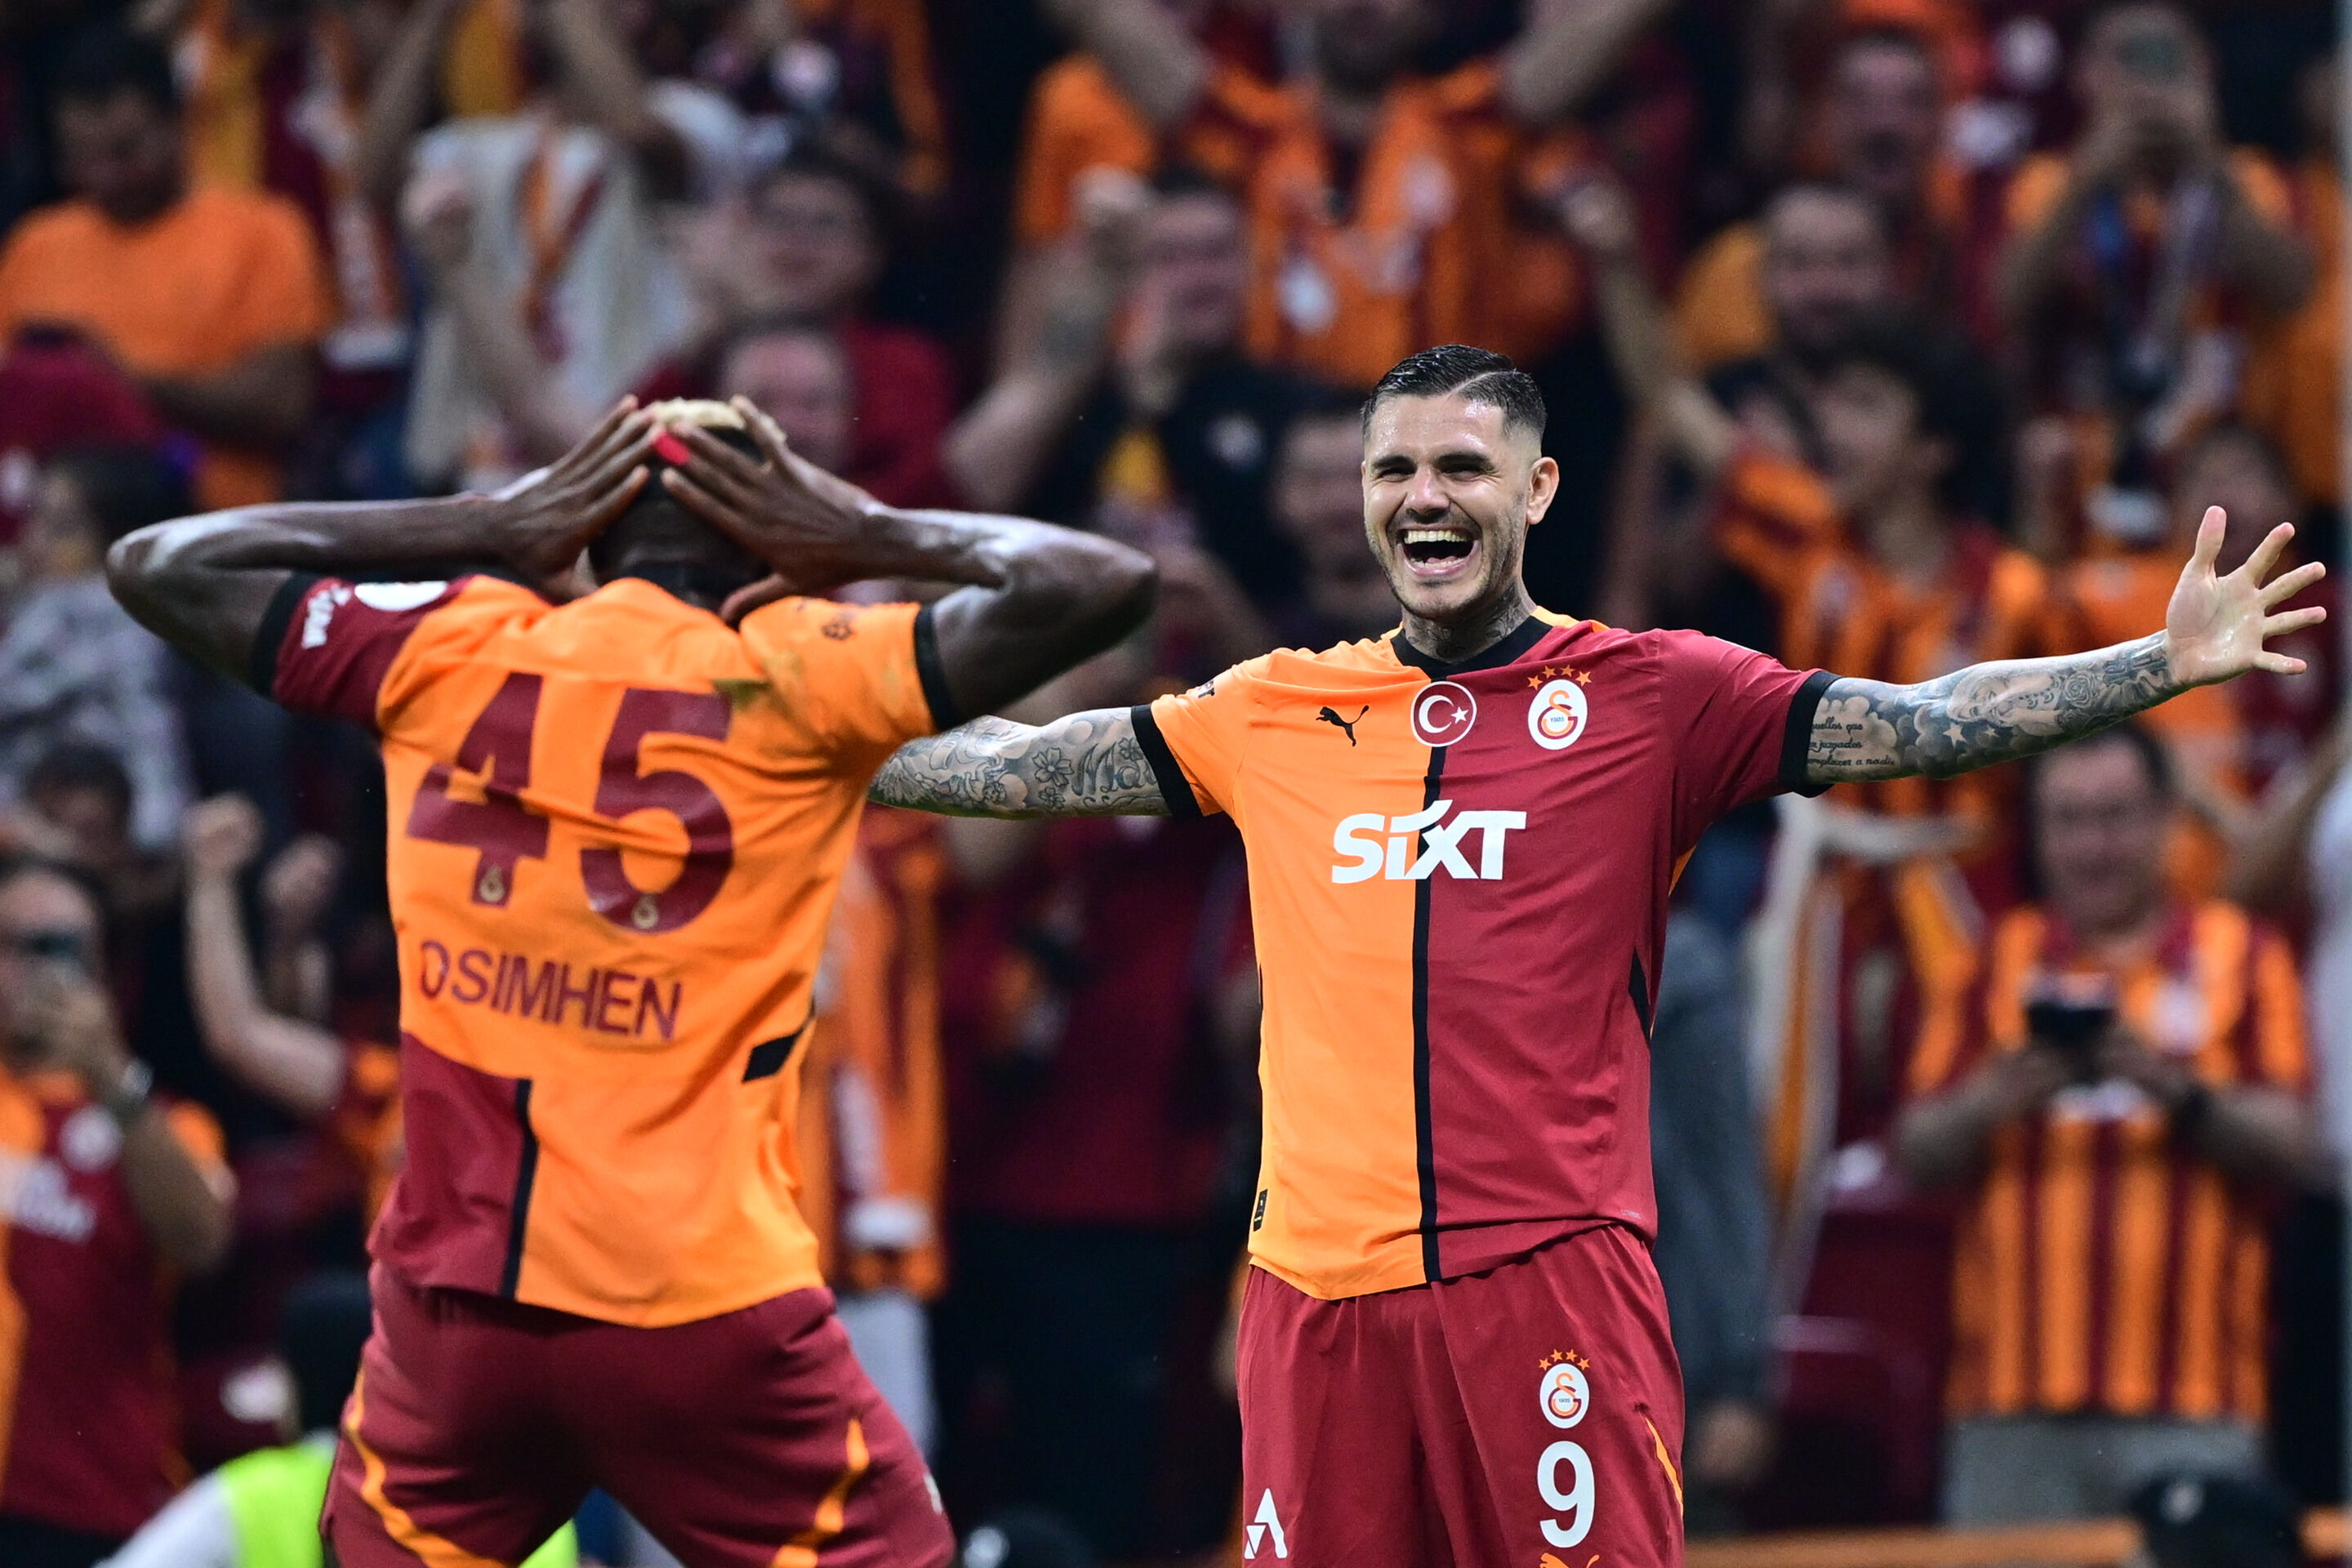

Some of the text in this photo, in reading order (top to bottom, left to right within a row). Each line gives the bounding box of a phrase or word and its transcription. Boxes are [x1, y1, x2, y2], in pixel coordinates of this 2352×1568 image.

[406, 671, 734, 934] 45
[420, 939, 682, 1040] OSIMHEN
[1537, 1440, 1595, 1548] 9
